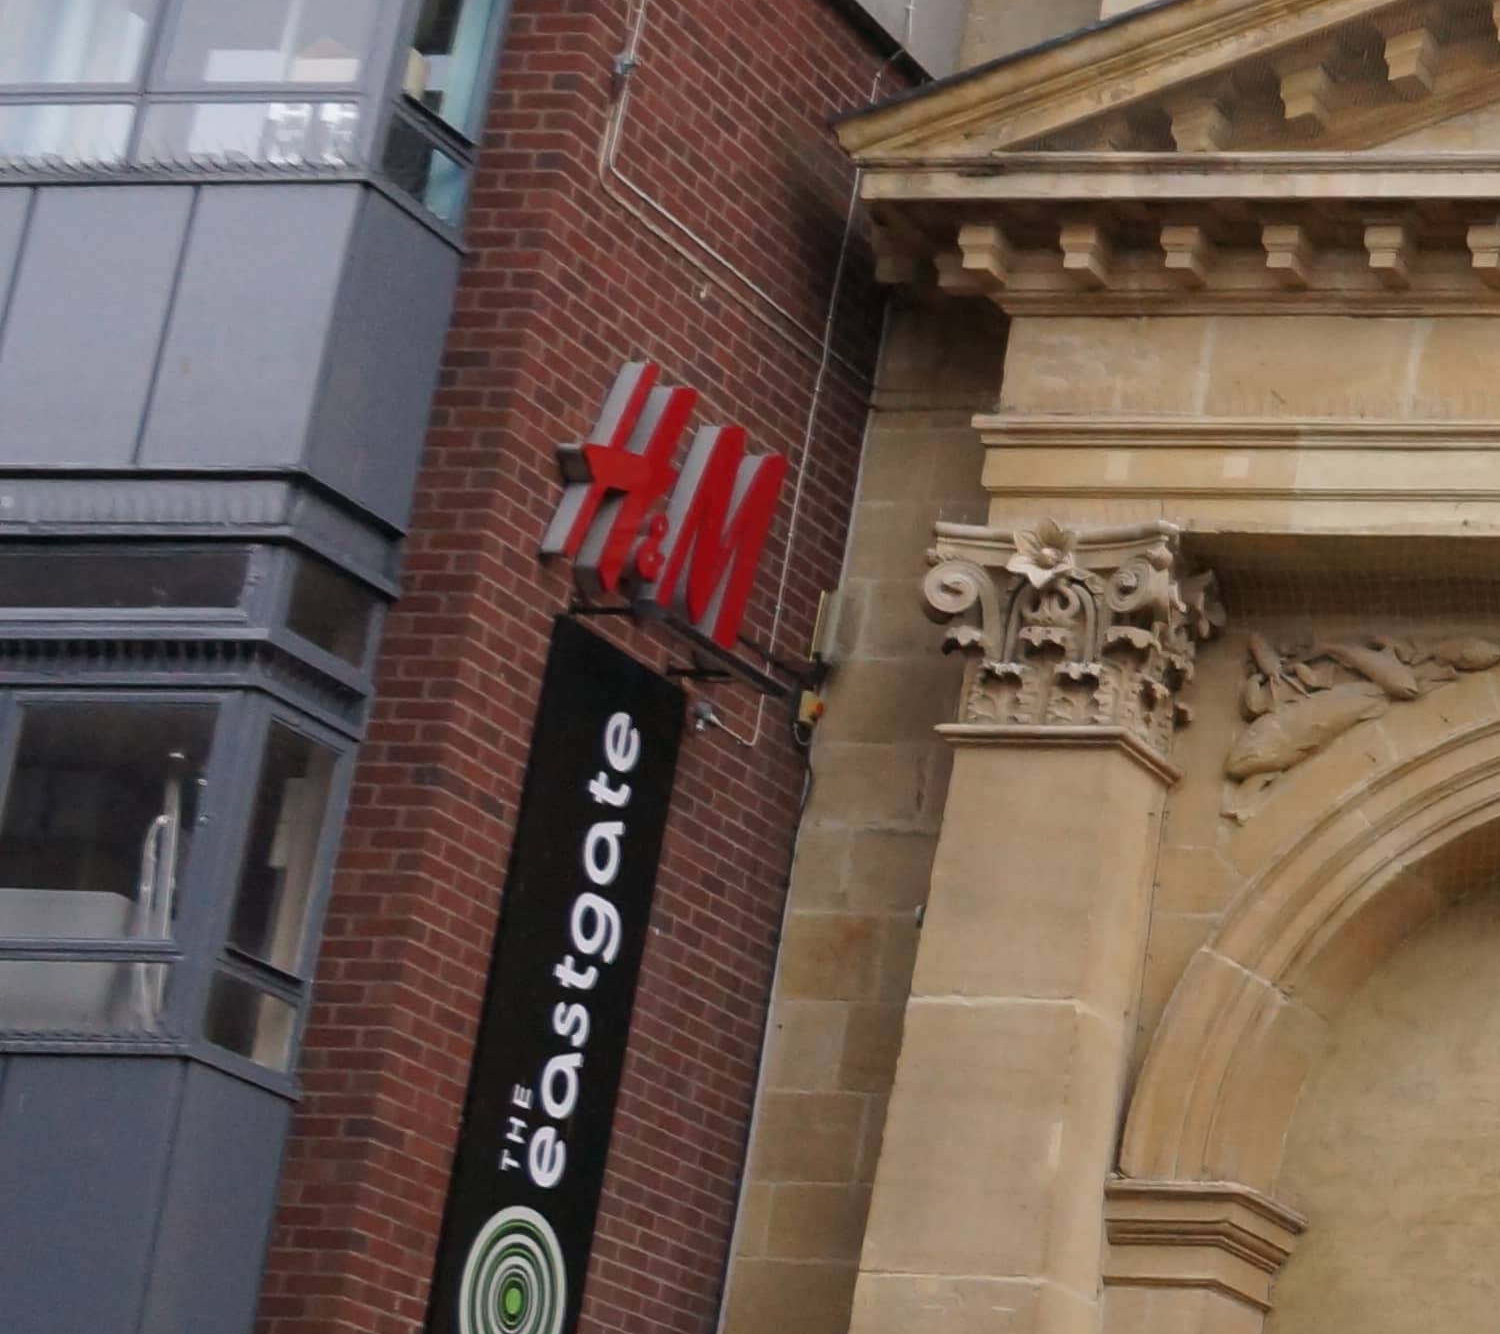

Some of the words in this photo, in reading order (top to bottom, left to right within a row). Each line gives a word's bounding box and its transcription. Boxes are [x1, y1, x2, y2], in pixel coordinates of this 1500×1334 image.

[546, 361, 787, 650] H&M
[527, 709, 643, 1190] eastgate
[498, 1080, 534, 1172] THE
